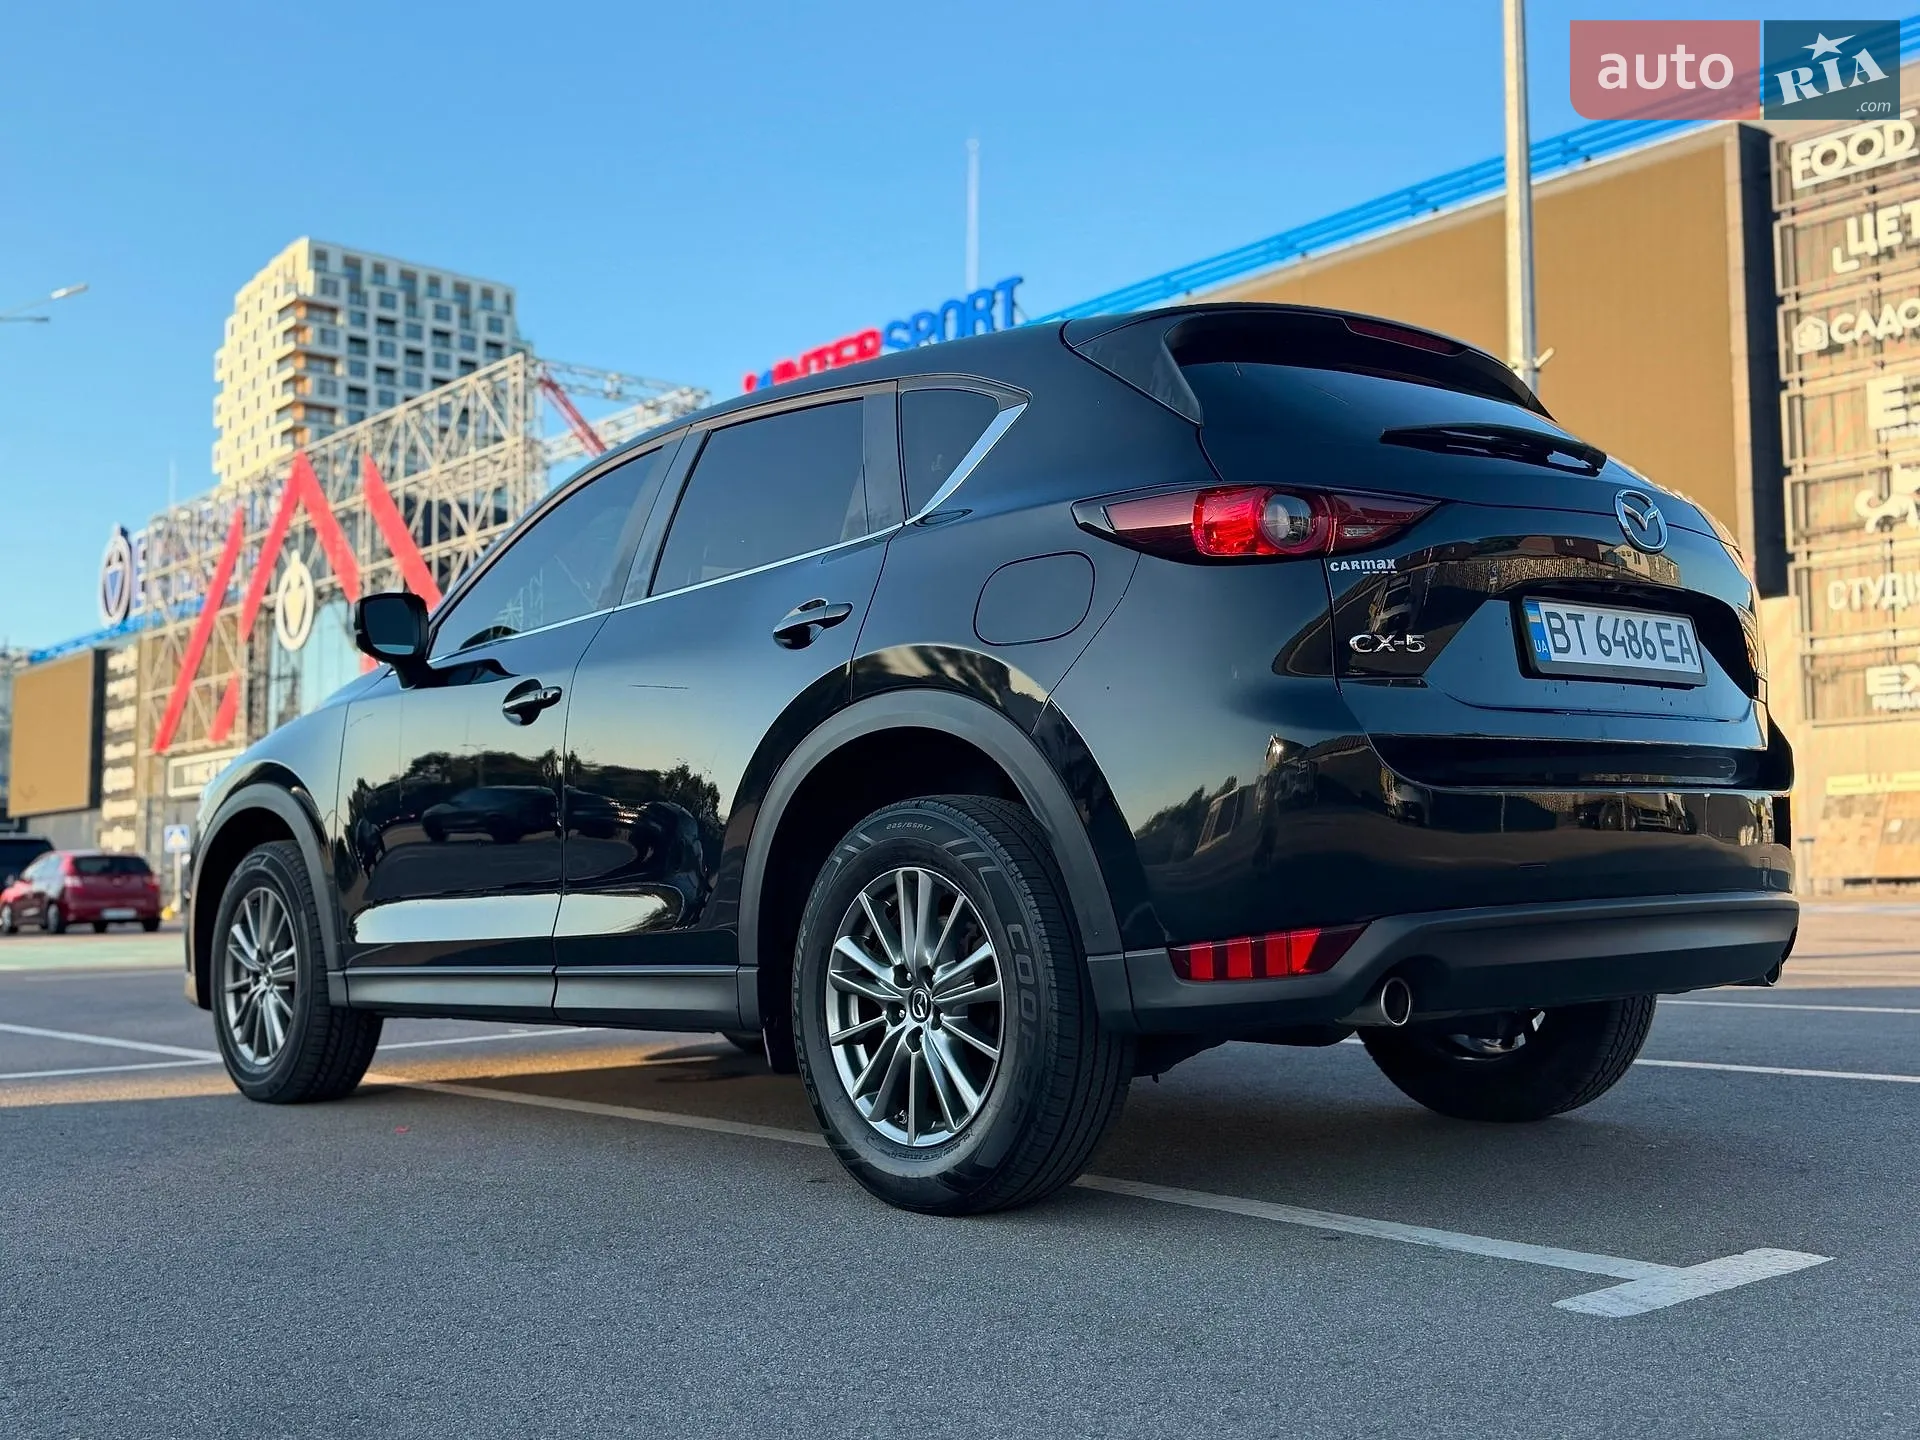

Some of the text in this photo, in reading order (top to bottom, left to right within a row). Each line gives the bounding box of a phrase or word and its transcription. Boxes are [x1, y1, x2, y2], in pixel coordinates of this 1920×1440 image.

[1791, 119, 1916, 190] FOOD
[1349, 633, 1426, 653] CX-5
[1533, 638, 1549, 653] UA
[1545, 611, 1697, 666] BT 6486 EA
